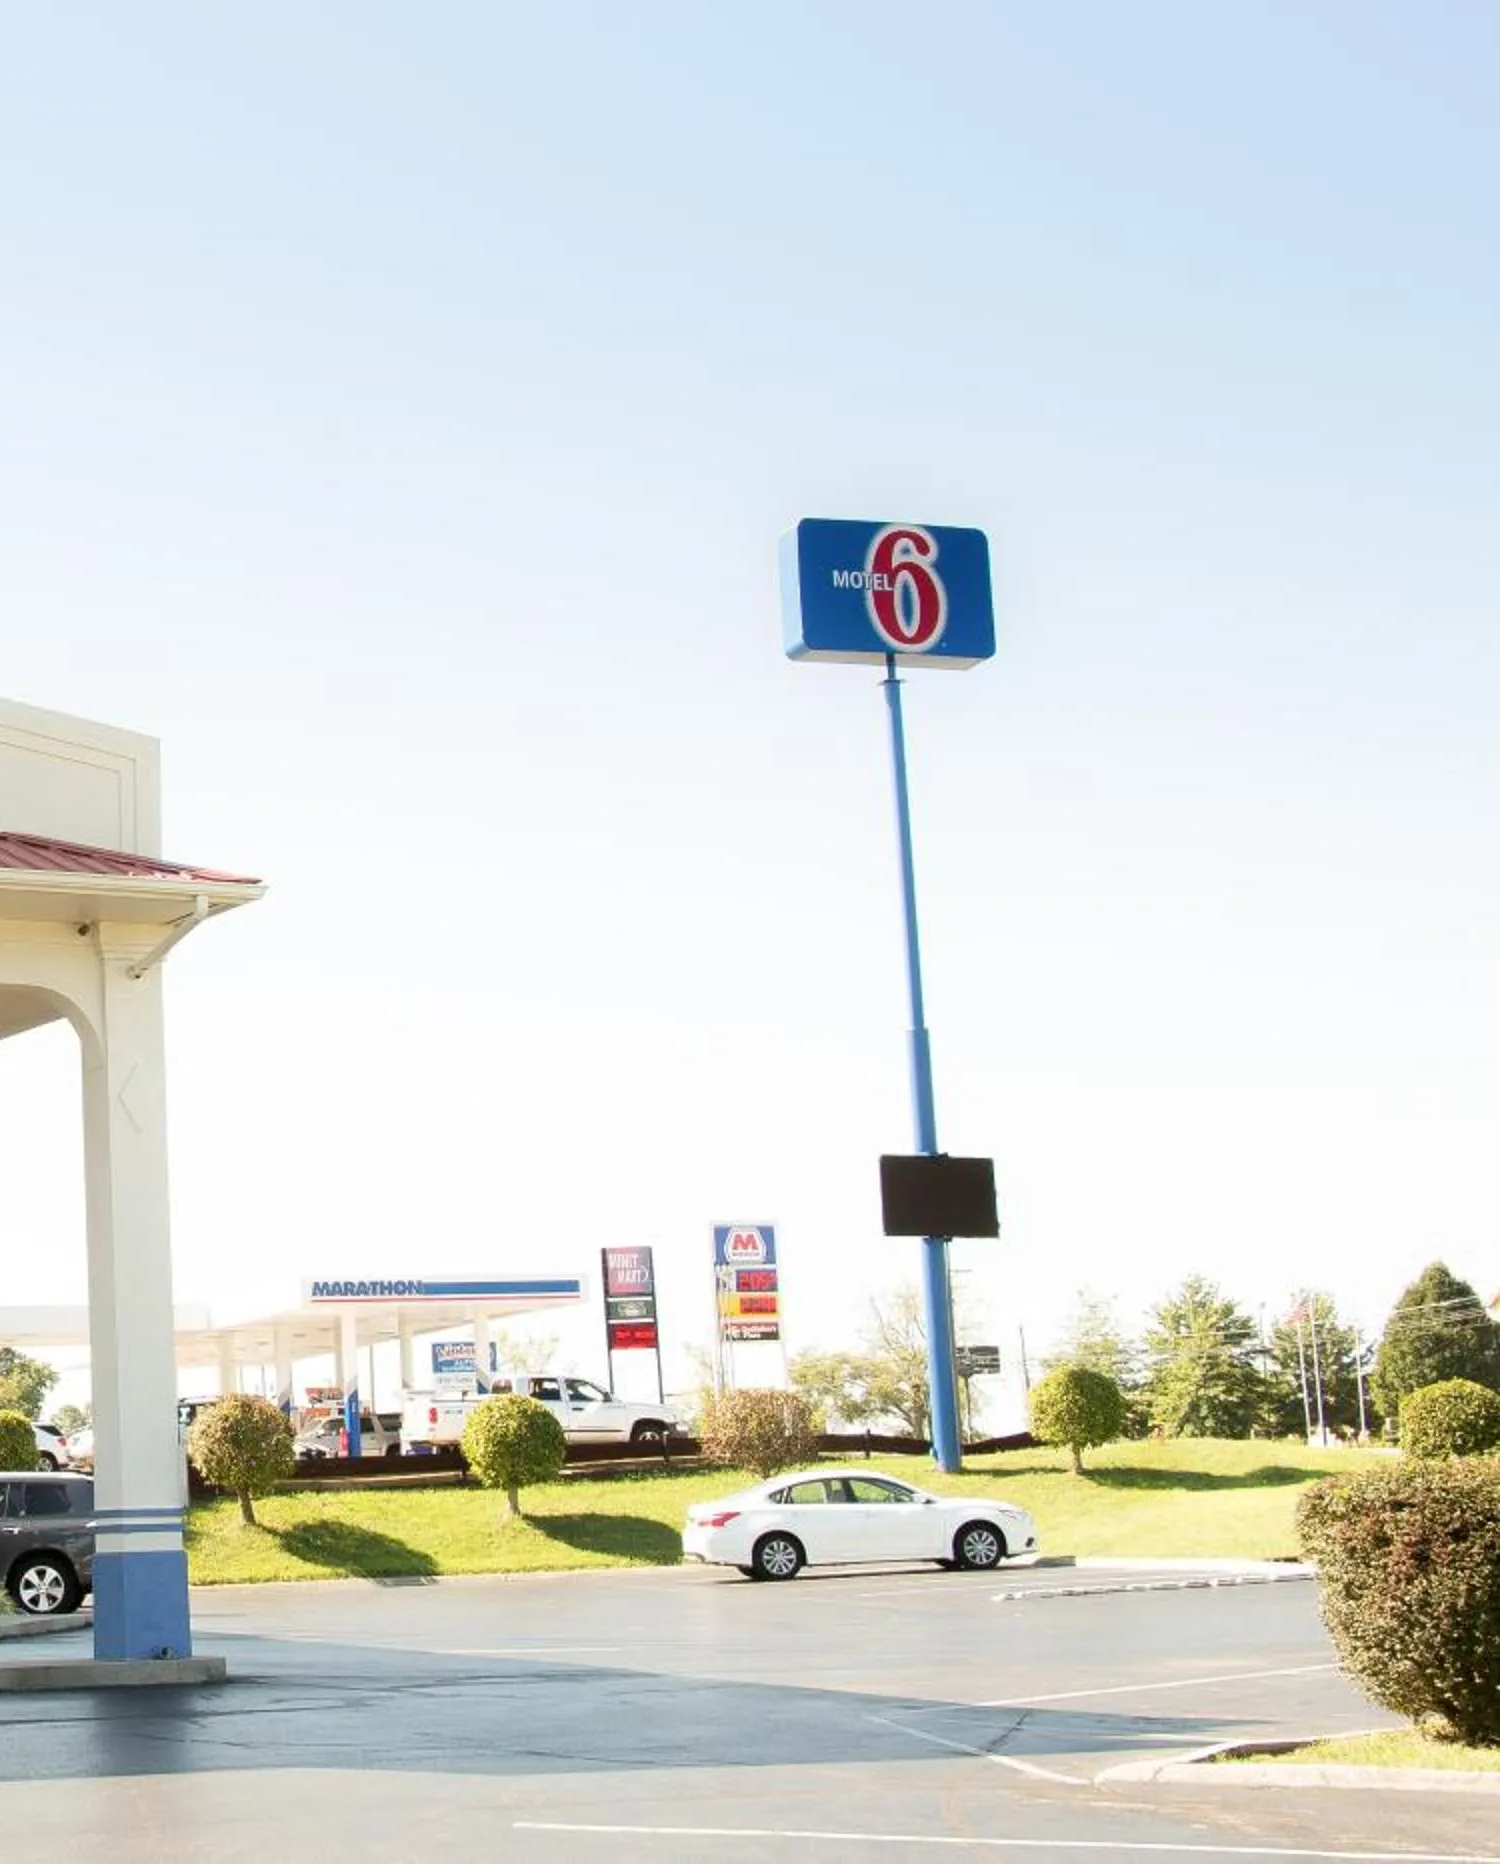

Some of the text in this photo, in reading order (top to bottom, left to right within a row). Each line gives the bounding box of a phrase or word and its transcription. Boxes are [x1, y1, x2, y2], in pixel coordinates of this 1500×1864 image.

[832, 527, 943, 647] MOTEL 6
[311, 1280, 423, 1297] MARATHON
